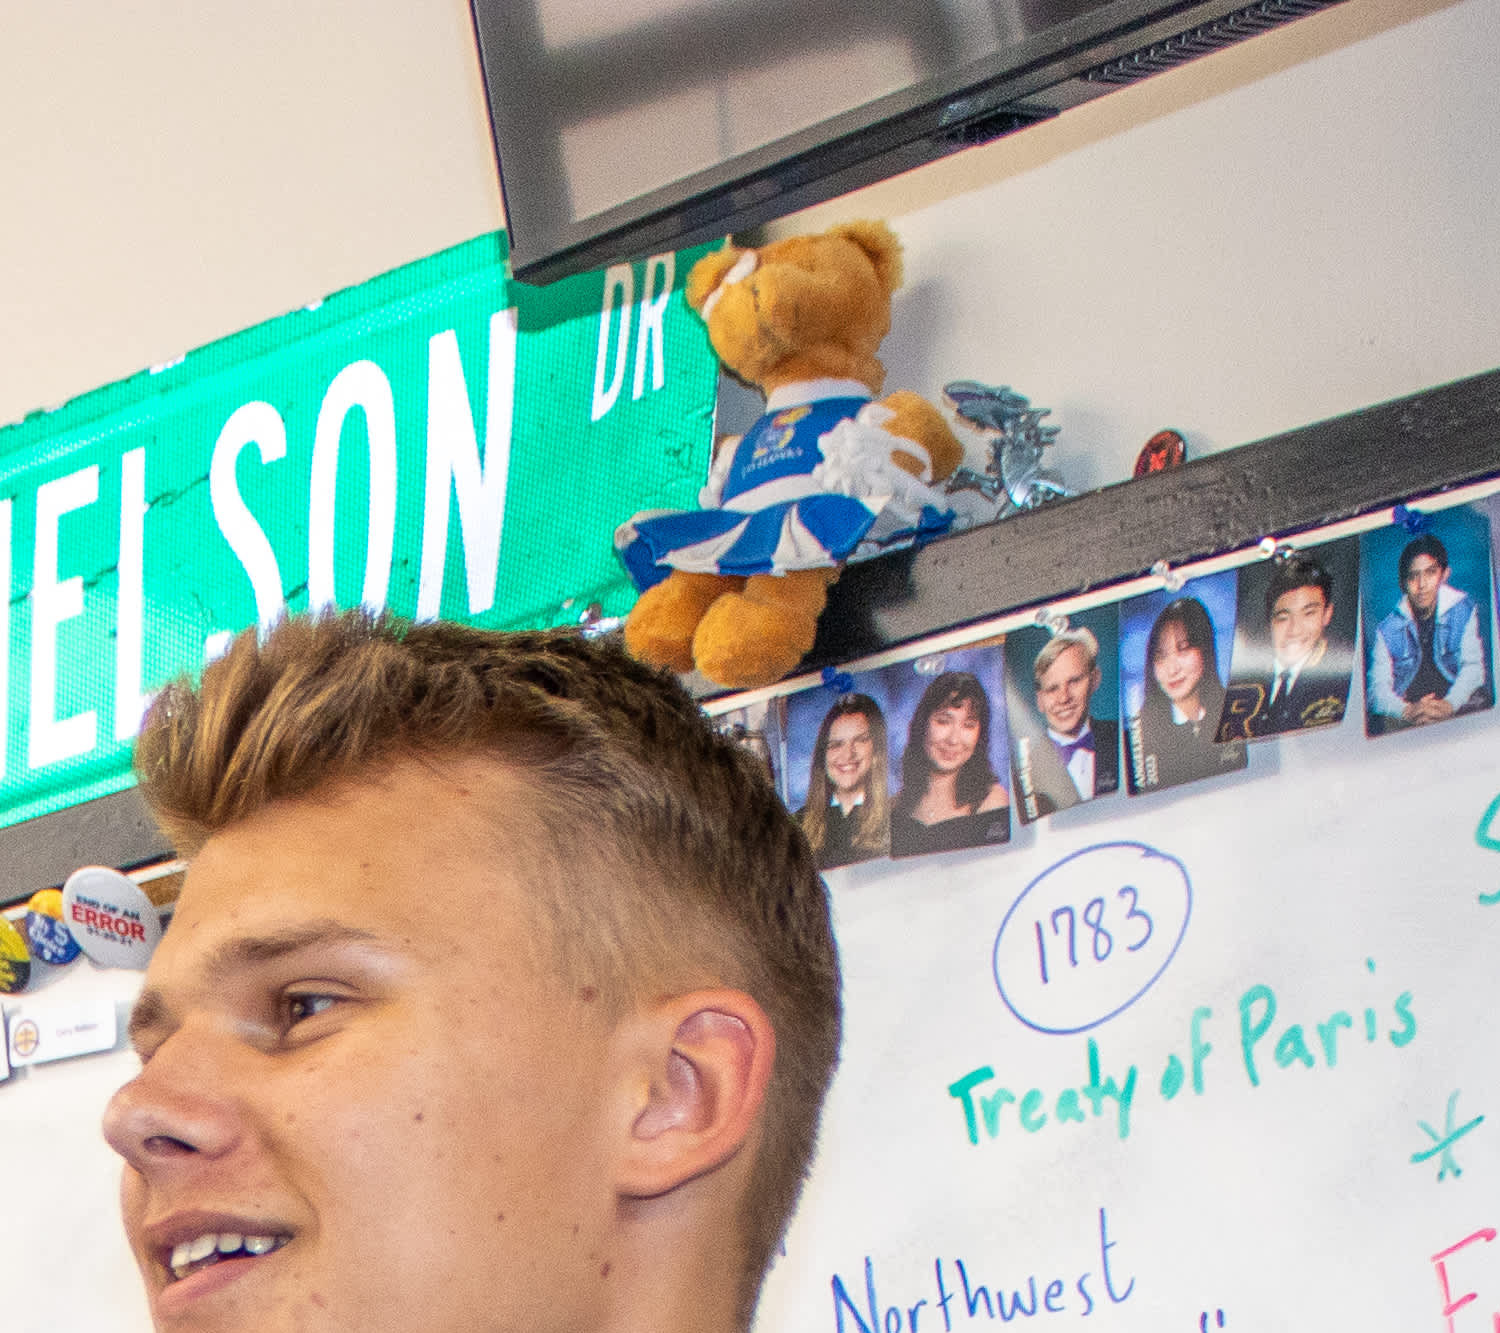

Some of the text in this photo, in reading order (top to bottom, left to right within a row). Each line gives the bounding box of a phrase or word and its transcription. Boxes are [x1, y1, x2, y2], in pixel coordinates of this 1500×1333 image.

[591, 251, 677, 422] DR
[71, 902, 148, 943] ERROR
[1034, 885, 1154, 985] 1783
[948, 957, 1419, 1146] Treaty of Paris
